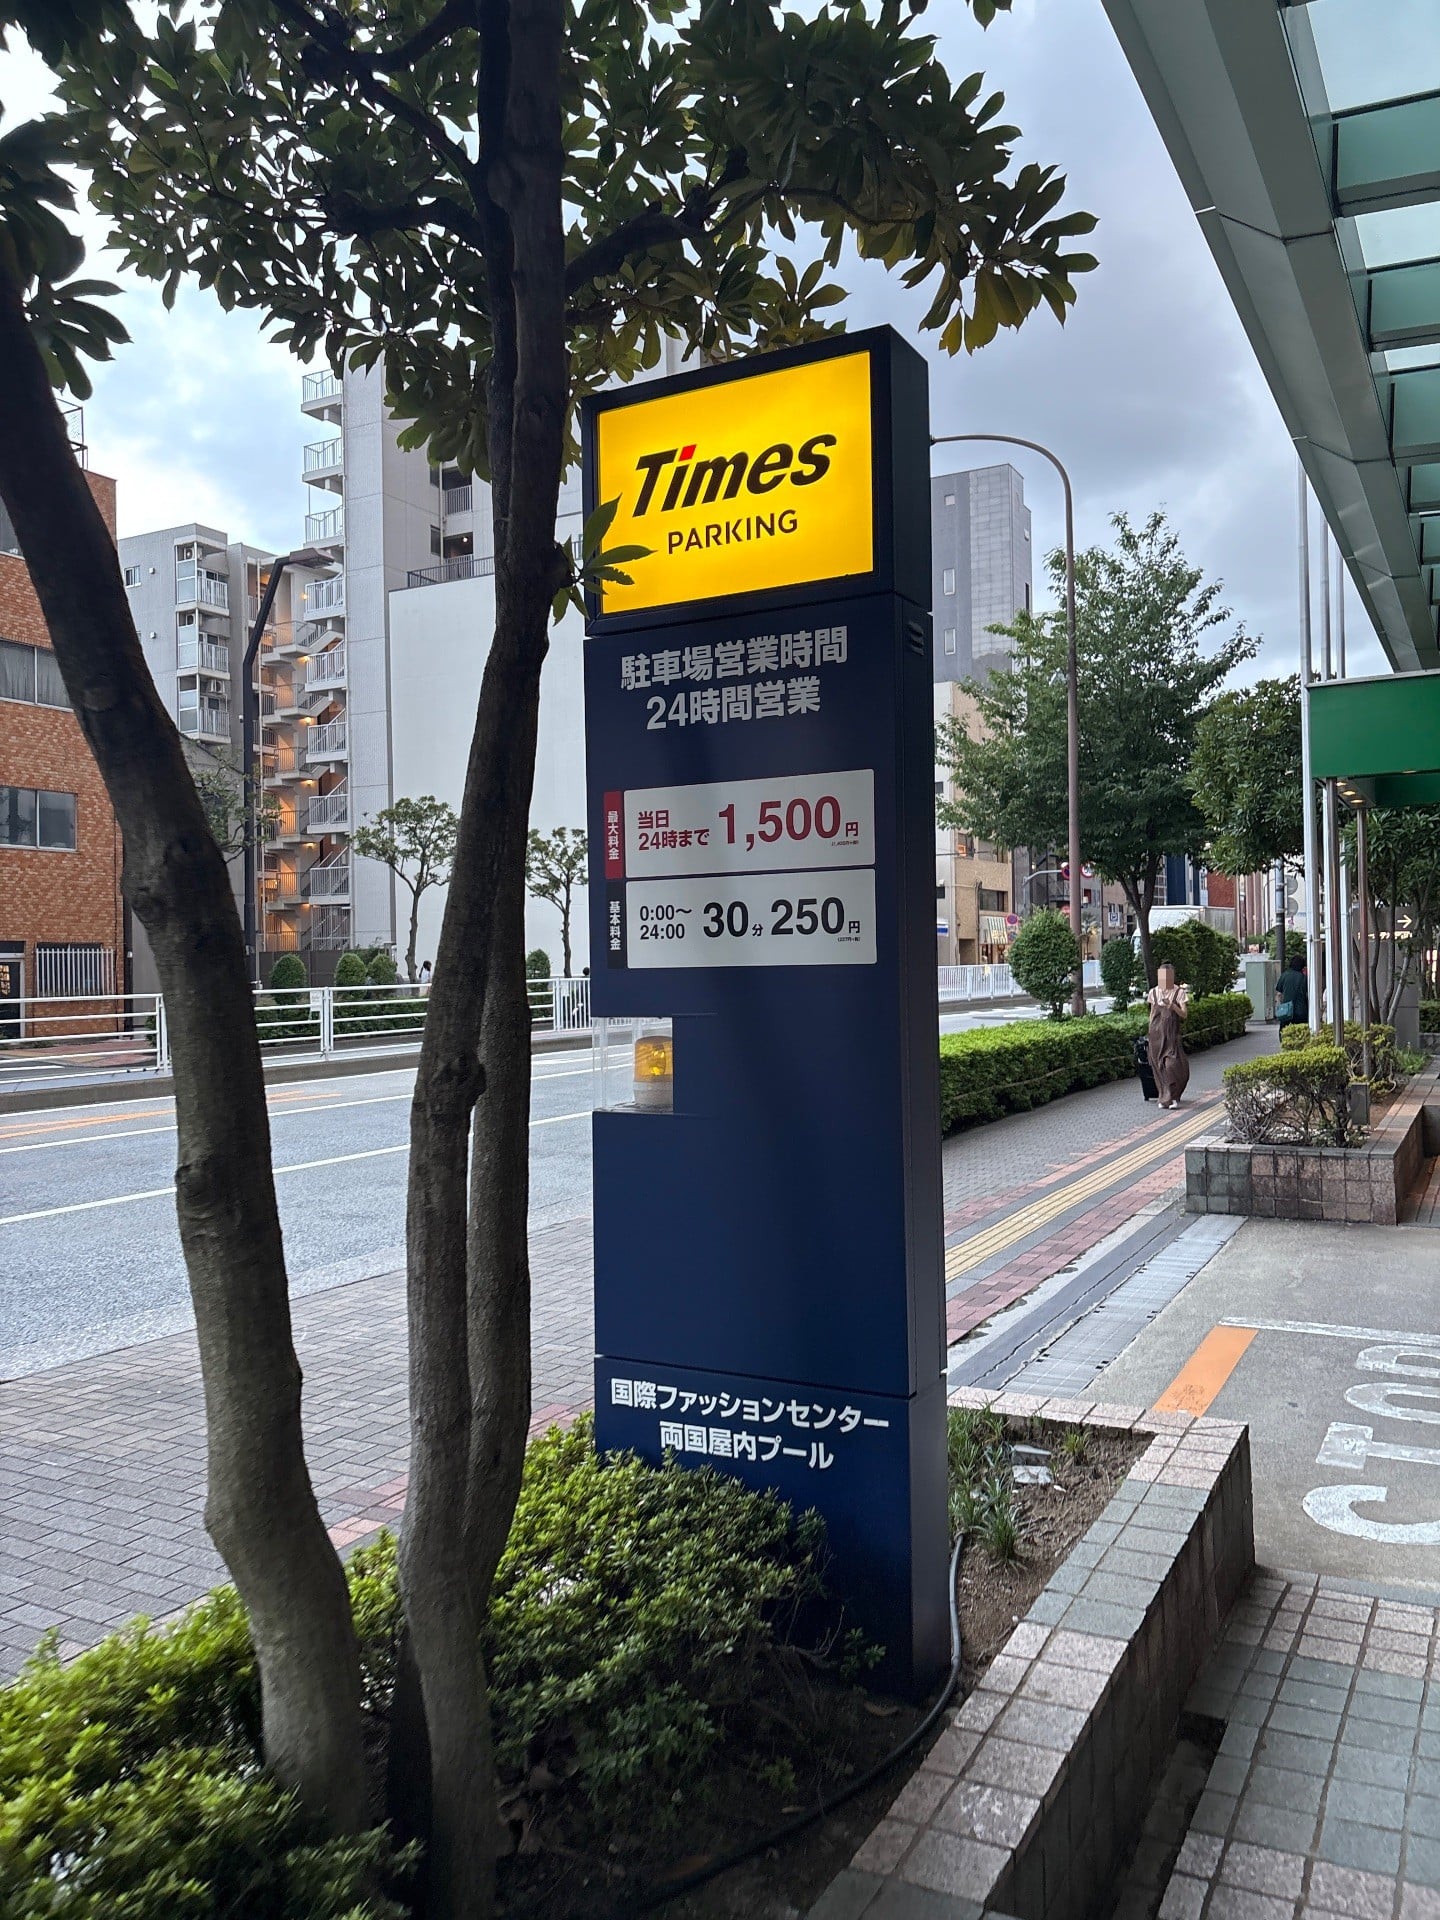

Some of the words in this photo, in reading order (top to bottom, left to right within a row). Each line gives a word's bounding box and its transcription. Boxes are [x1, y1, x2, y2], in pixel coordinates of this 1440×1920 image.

[632, 434, 837, 518] Times
[668, 509, 799, 555] PARKING
[621, 626, 848, 691] 駐車場営業時間
[646, 676, 822, 730] 24時間営業
[607, 811, 620, 860] 最大料金
[638, 810, 670, 829] 当日
[638, 829, 710, 850] 24時まで
[609, 901, 621, 950] 基本料金
[639, 923, 685, 940] 24:00
[611, 1378, 889, 1433] 国際ファッションセンター
[659, 1421, 834, 1470] 両国屋内プール
